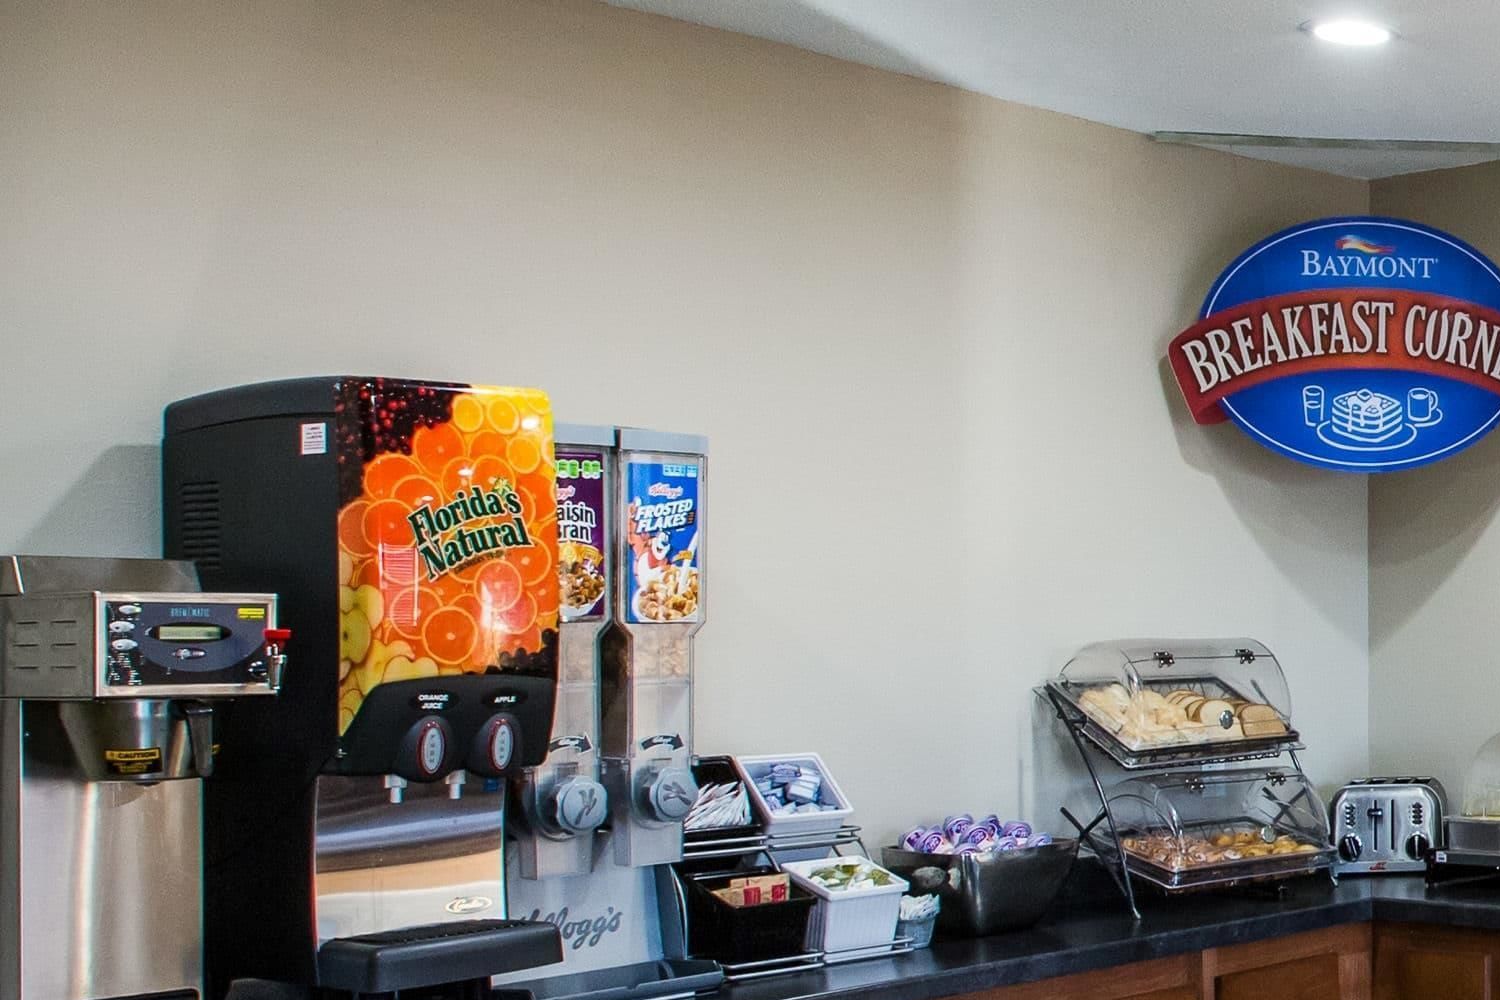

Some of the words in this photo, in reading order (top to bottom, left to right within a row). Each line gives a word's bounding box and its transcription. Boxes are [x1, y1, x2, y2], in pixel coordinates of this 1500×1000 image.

[1300, 249, 1435, 279] BAYMONT
[1180, 300, 1395, 394] BREAKFAST
[407, 486, 523, 547] Florida's
[556, 501, 596, 527] aisin
[634, 499, 693, 521] FROSTED
[636, 512, 687, 534] FLAKES
[419, 517, 532, 580] Natural
[418, 694, 449, 702] ORANGE
[421, 702, 443, 710] JUICE
[494, 695, 516, 704] APPLE
[521, 906, 623, 950] logg's
